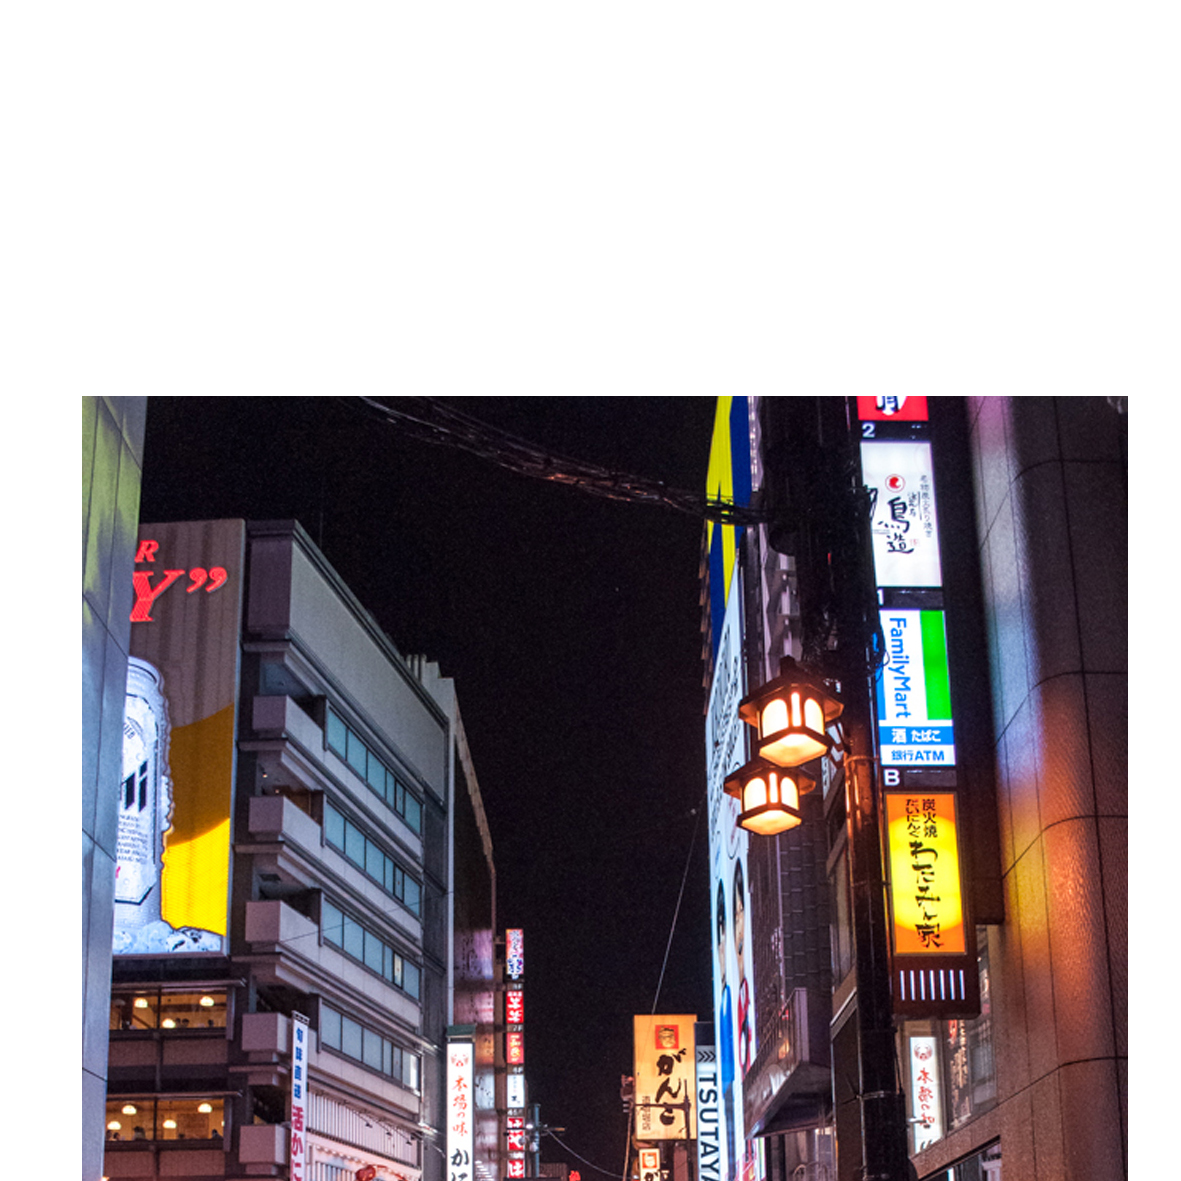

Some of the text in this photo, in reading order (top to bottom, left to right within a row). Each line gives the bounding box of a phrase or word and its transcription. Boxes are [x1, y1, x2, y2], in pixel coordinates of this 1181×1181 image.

[862, 423, 875, 437] 2
[889, 617, 911, 718] FamilyMart
[892, 728, 942, 744] 酒 たばこ
[884, 770, 900, 785] B
[923, 798, 938, 838] 炭火焼
[452, 1074, 469, 1137] 本場の味
[655, 1048, 687, 1127] がんこ
